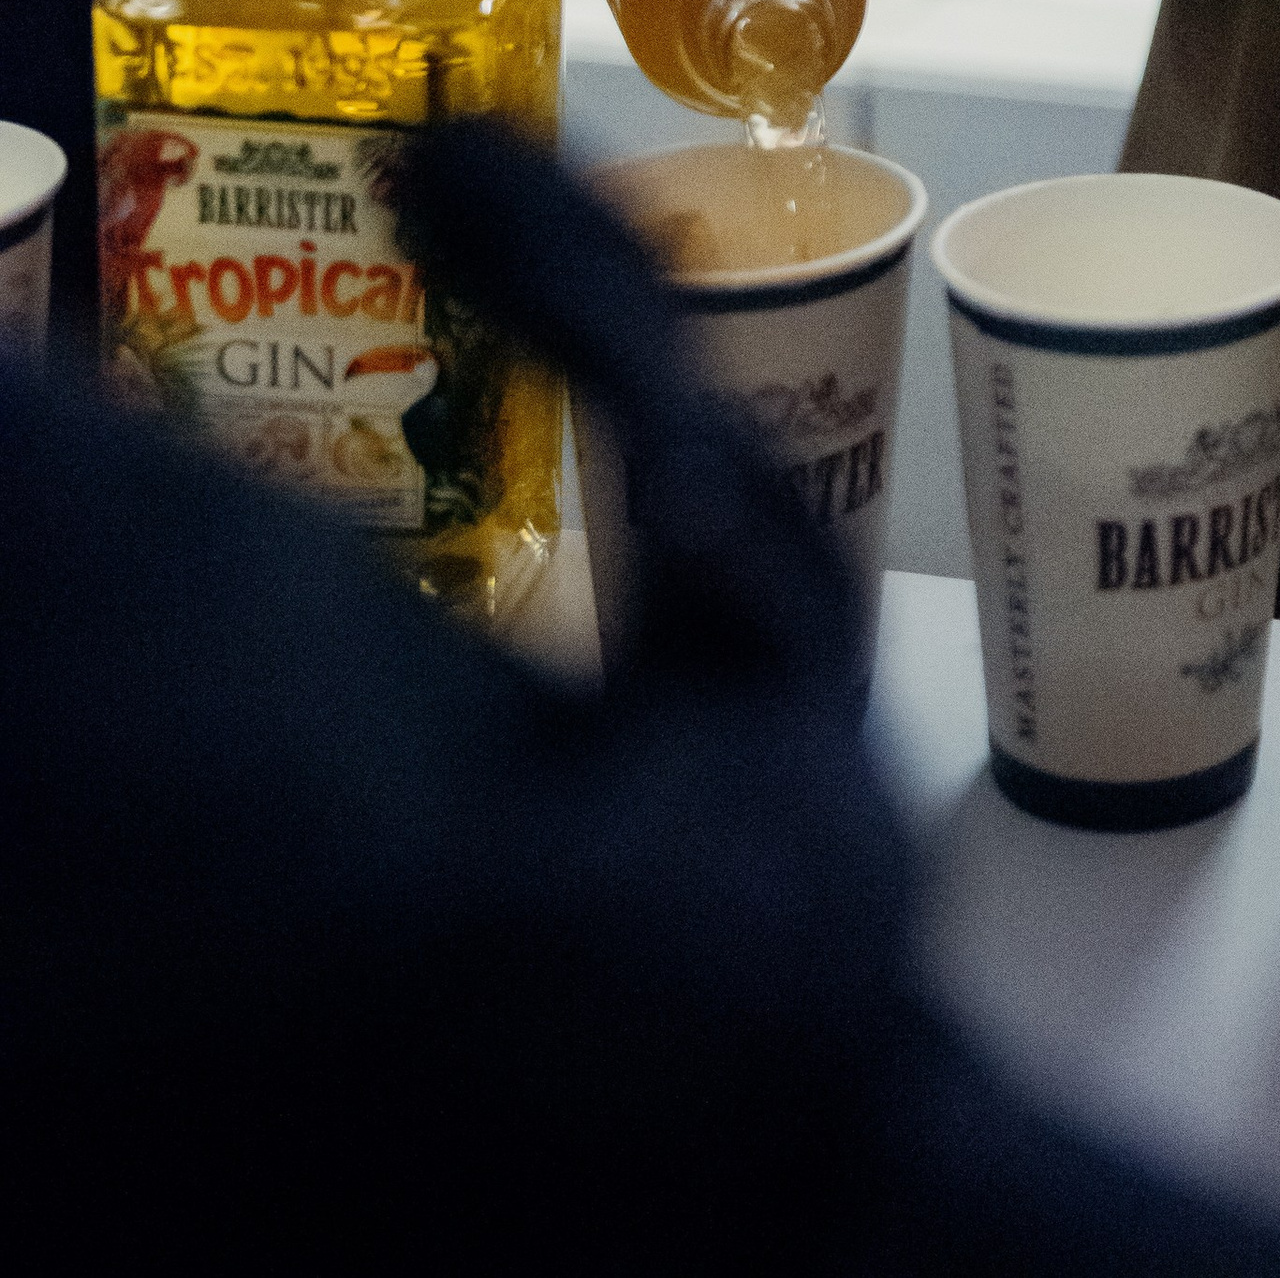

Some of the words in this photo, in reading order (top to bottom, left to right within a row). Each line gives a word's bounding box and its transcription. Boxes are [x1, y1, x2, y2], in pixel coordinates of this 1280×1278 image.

[197, 183, 360, 235] BARRISTER
[215, 339, 335, 391] GIN
[992, 362, 1026, 536] CRAFTED
